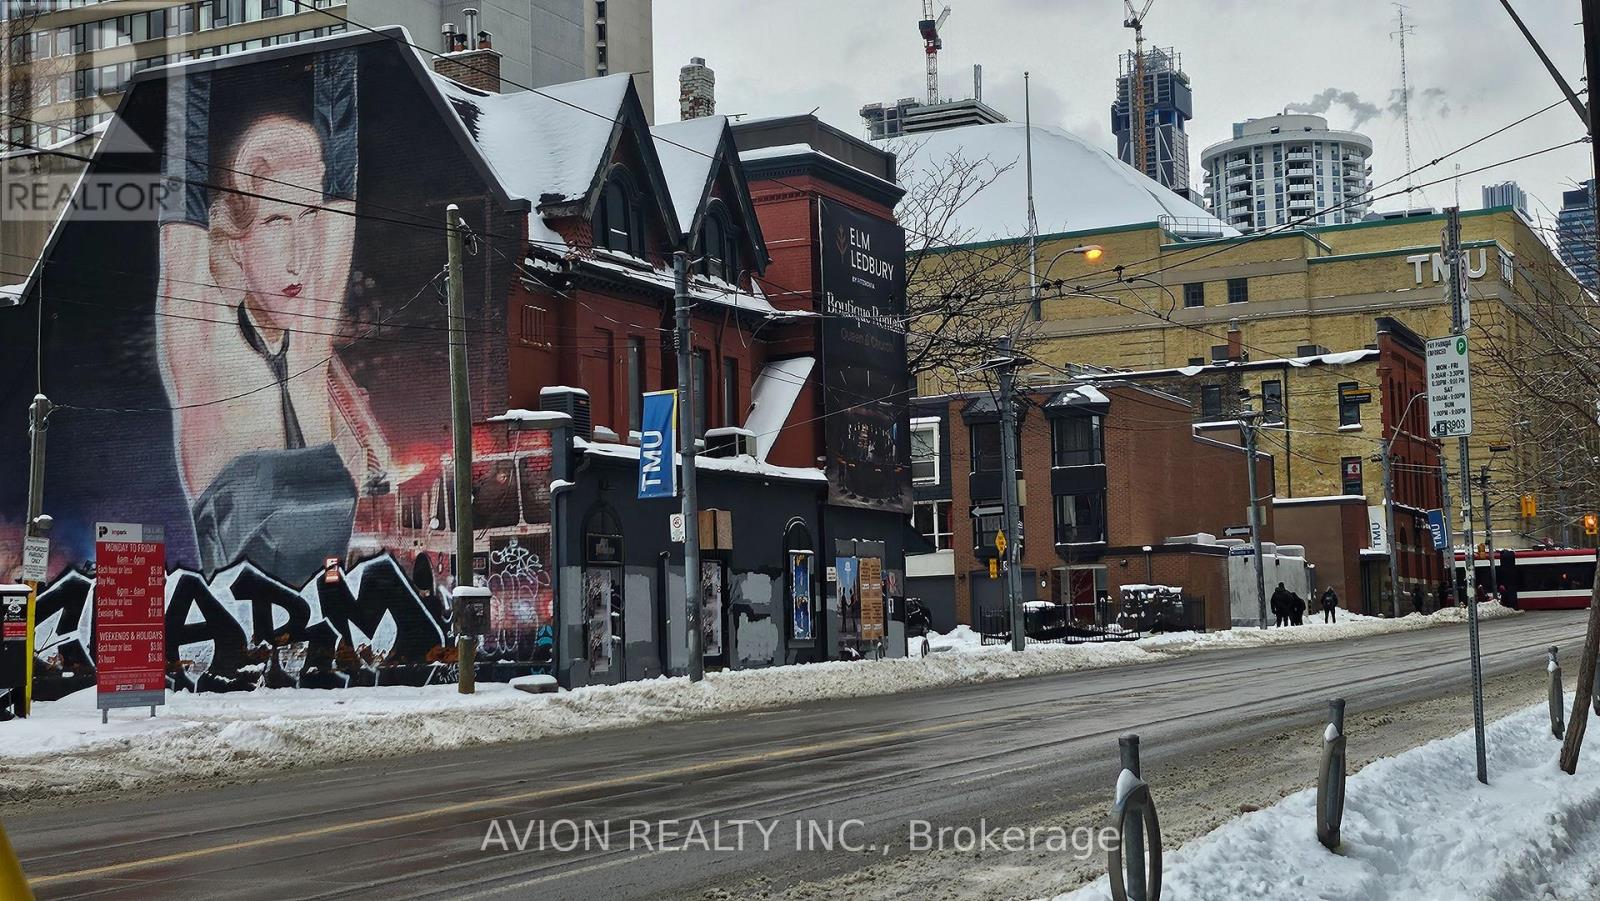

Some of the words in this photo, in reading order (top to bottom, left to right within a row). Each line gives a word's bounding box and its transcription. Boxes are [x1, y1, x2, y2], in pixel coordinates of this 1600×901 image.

[849, 227, 871, 251] ELM
[850, 249, 894, 281] LEDBURY
[827, 291, 871, 328] Boutique
[1444, 401, 1455, 409] SUN
[641, 430, 663, 492] TMU
[1371, 522, 1382, 548] TMU
[1432, 523, 1442, 547] TMU
[105, 543, 128, 552] MONDAY
[130, 543, 136, 552] TO
[137, 543, 157, 553] FRIDAY
[98, 565, 108, 574] Each
[108, 566, 118, 574] hour
[124, 566, 132, 574] less
[98, 576, 106, 587] Day
[98, 597, 108, 606] Each
[109, 597, 118, 605] hour
[124, 597, 132, 606] less
[100, 631, 129, 641] WEEKENDS
[131, 631, 135, 641] &
[136, 630, 163, 640] HOLIDAYS
[98, 643, 108, 652] Each
[109, 643, 118, 652] hour
[123, 643, 132, 652] less
[104, 655, 115, 663] hours
